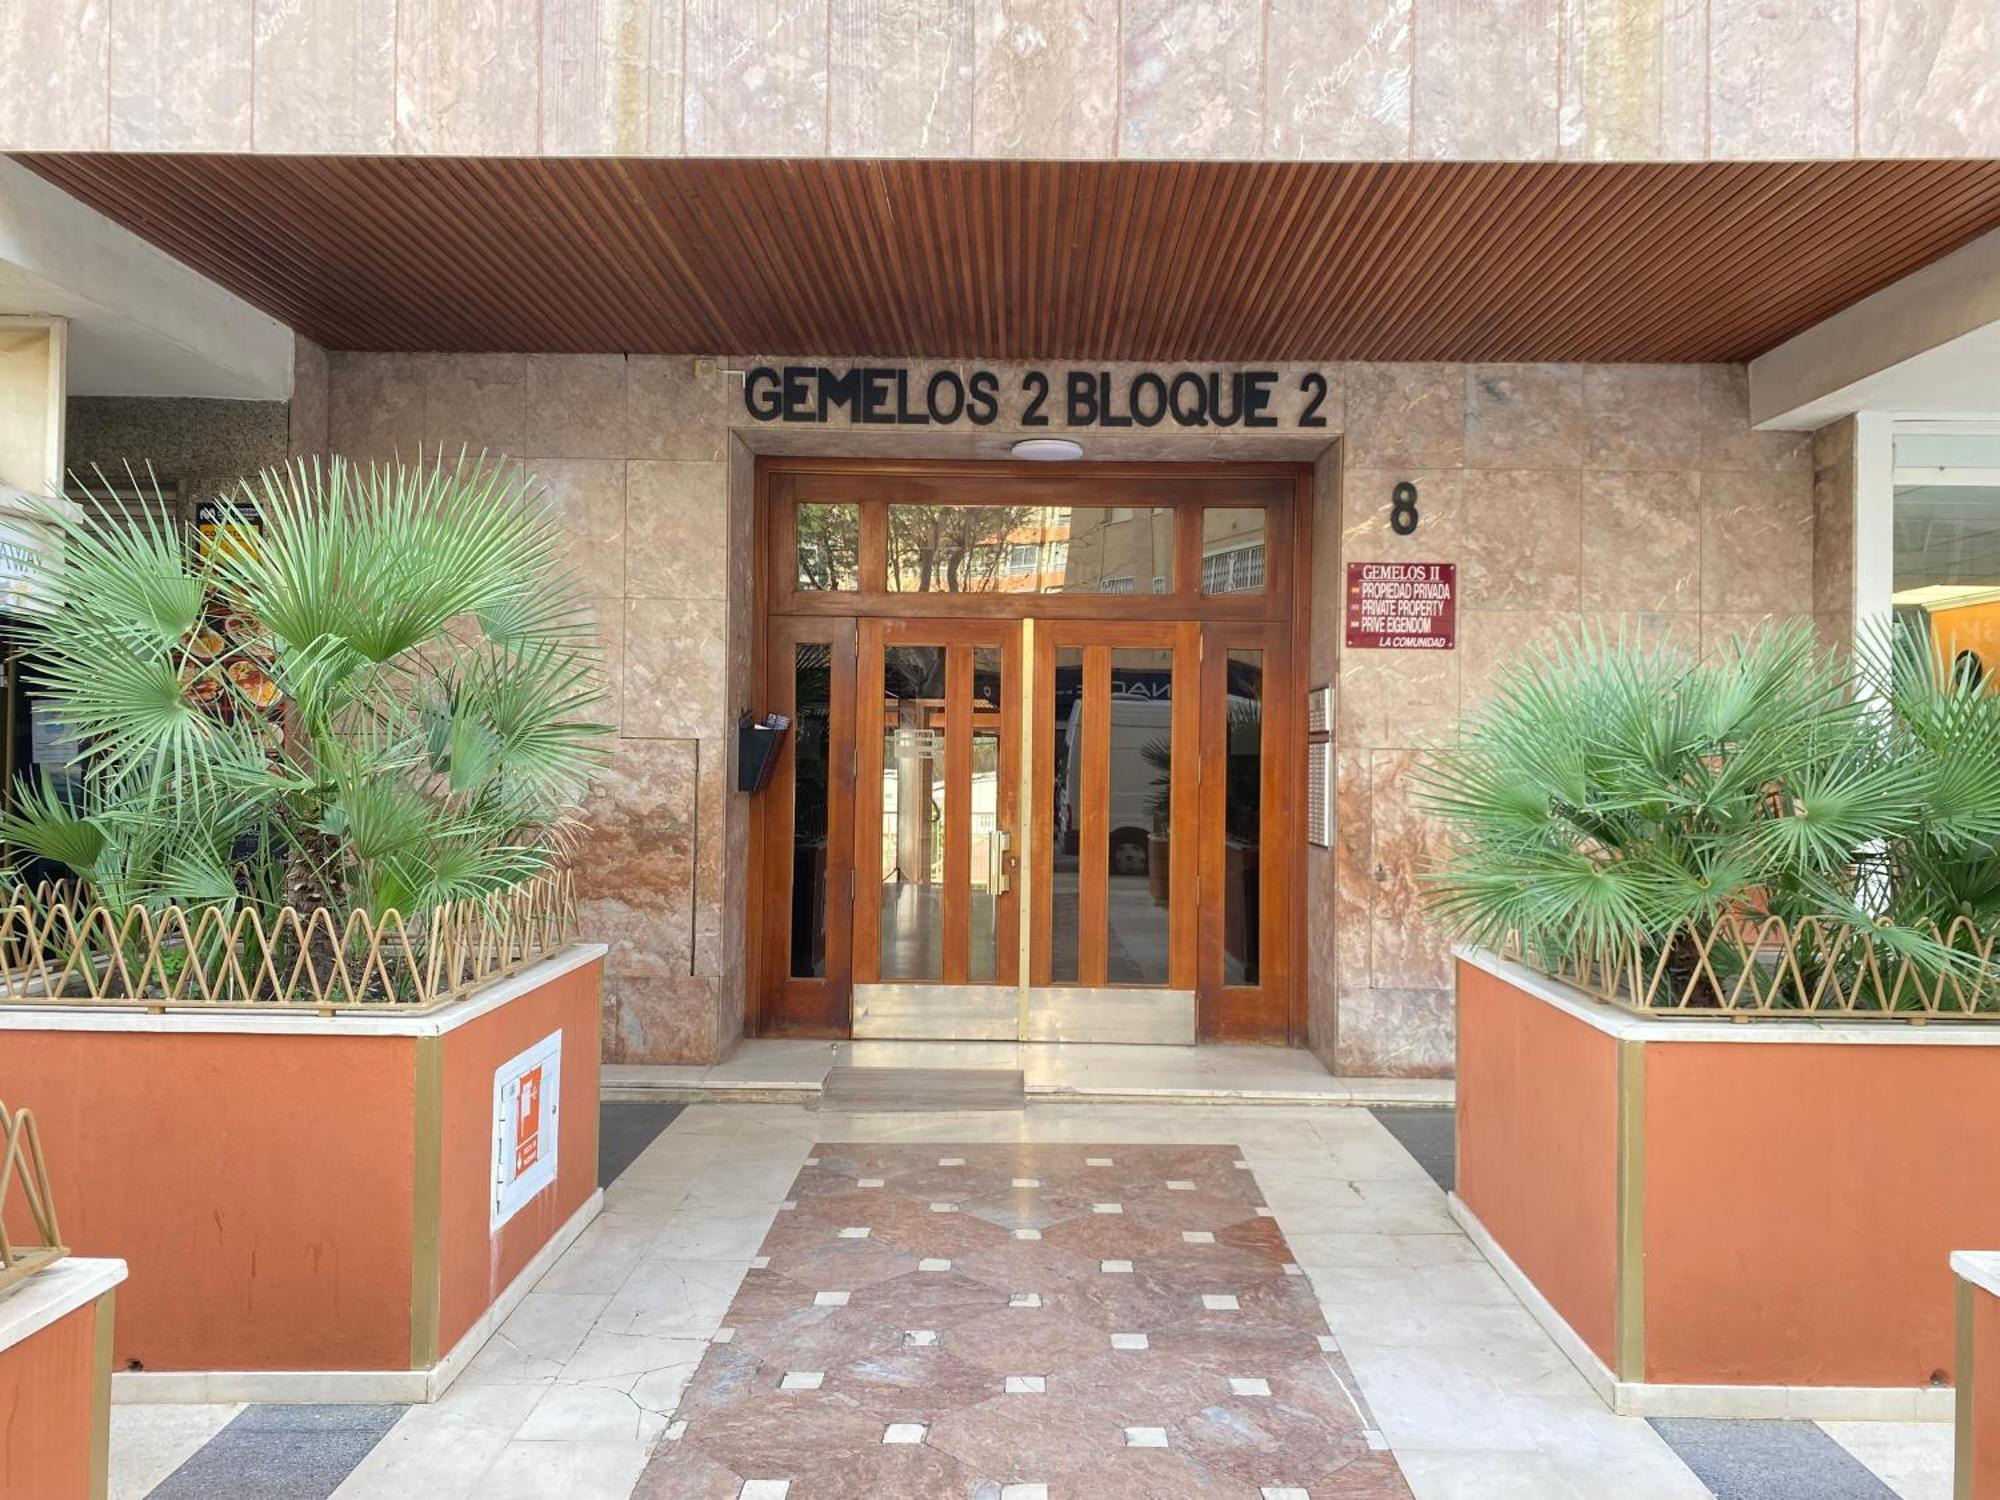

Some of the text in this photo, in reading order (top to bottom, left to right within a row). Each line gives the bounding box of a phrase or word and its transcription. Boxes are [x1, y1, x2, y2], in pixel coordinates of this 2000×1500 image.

[745, 367, 1328, 427] GEMELOS 2 BLOQUE 2
[1390, 481, 1418, 535] 8
[1363, 565, 1440, 580] GEMELOS II
[1362, 583, 1451, 600] PROPIEDAD PRIVADA
[1362, 600, 1444, 616] PRIVATE PROPERTY
[1361, 617, 1431, 633] PRIVE EIGENDOM
[1379, 637, 1446, 648] LA COMUNIDAD
